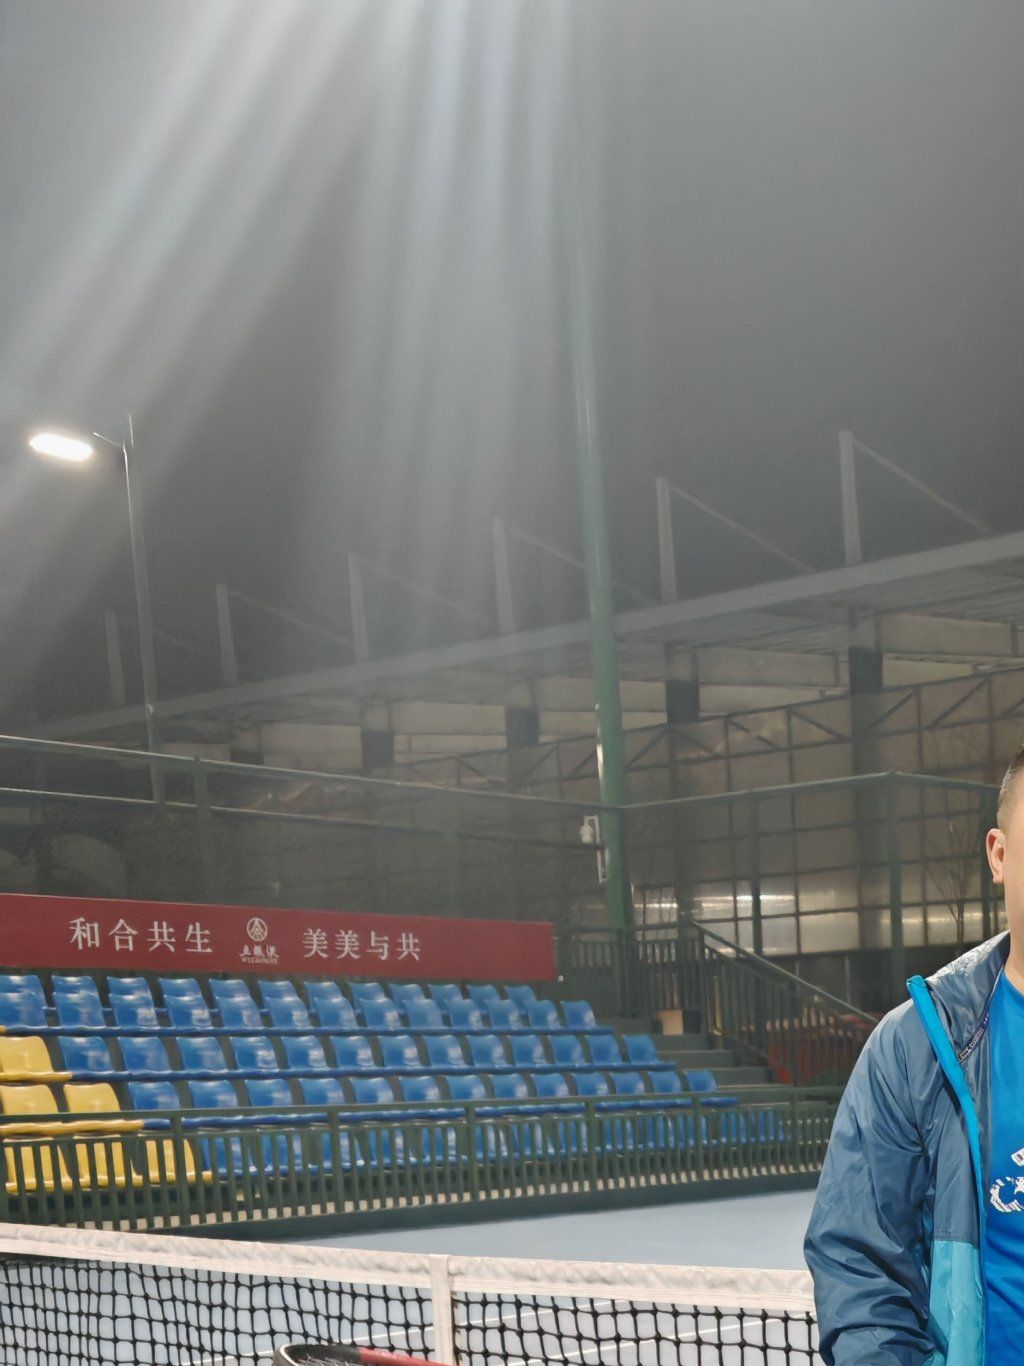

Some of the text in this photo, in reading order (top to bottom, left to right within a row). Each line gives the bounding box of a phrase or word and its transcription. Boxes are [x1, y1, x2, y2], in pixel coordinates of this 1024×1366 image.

[69, 916, 420, 961] 和合共生 美美与共
